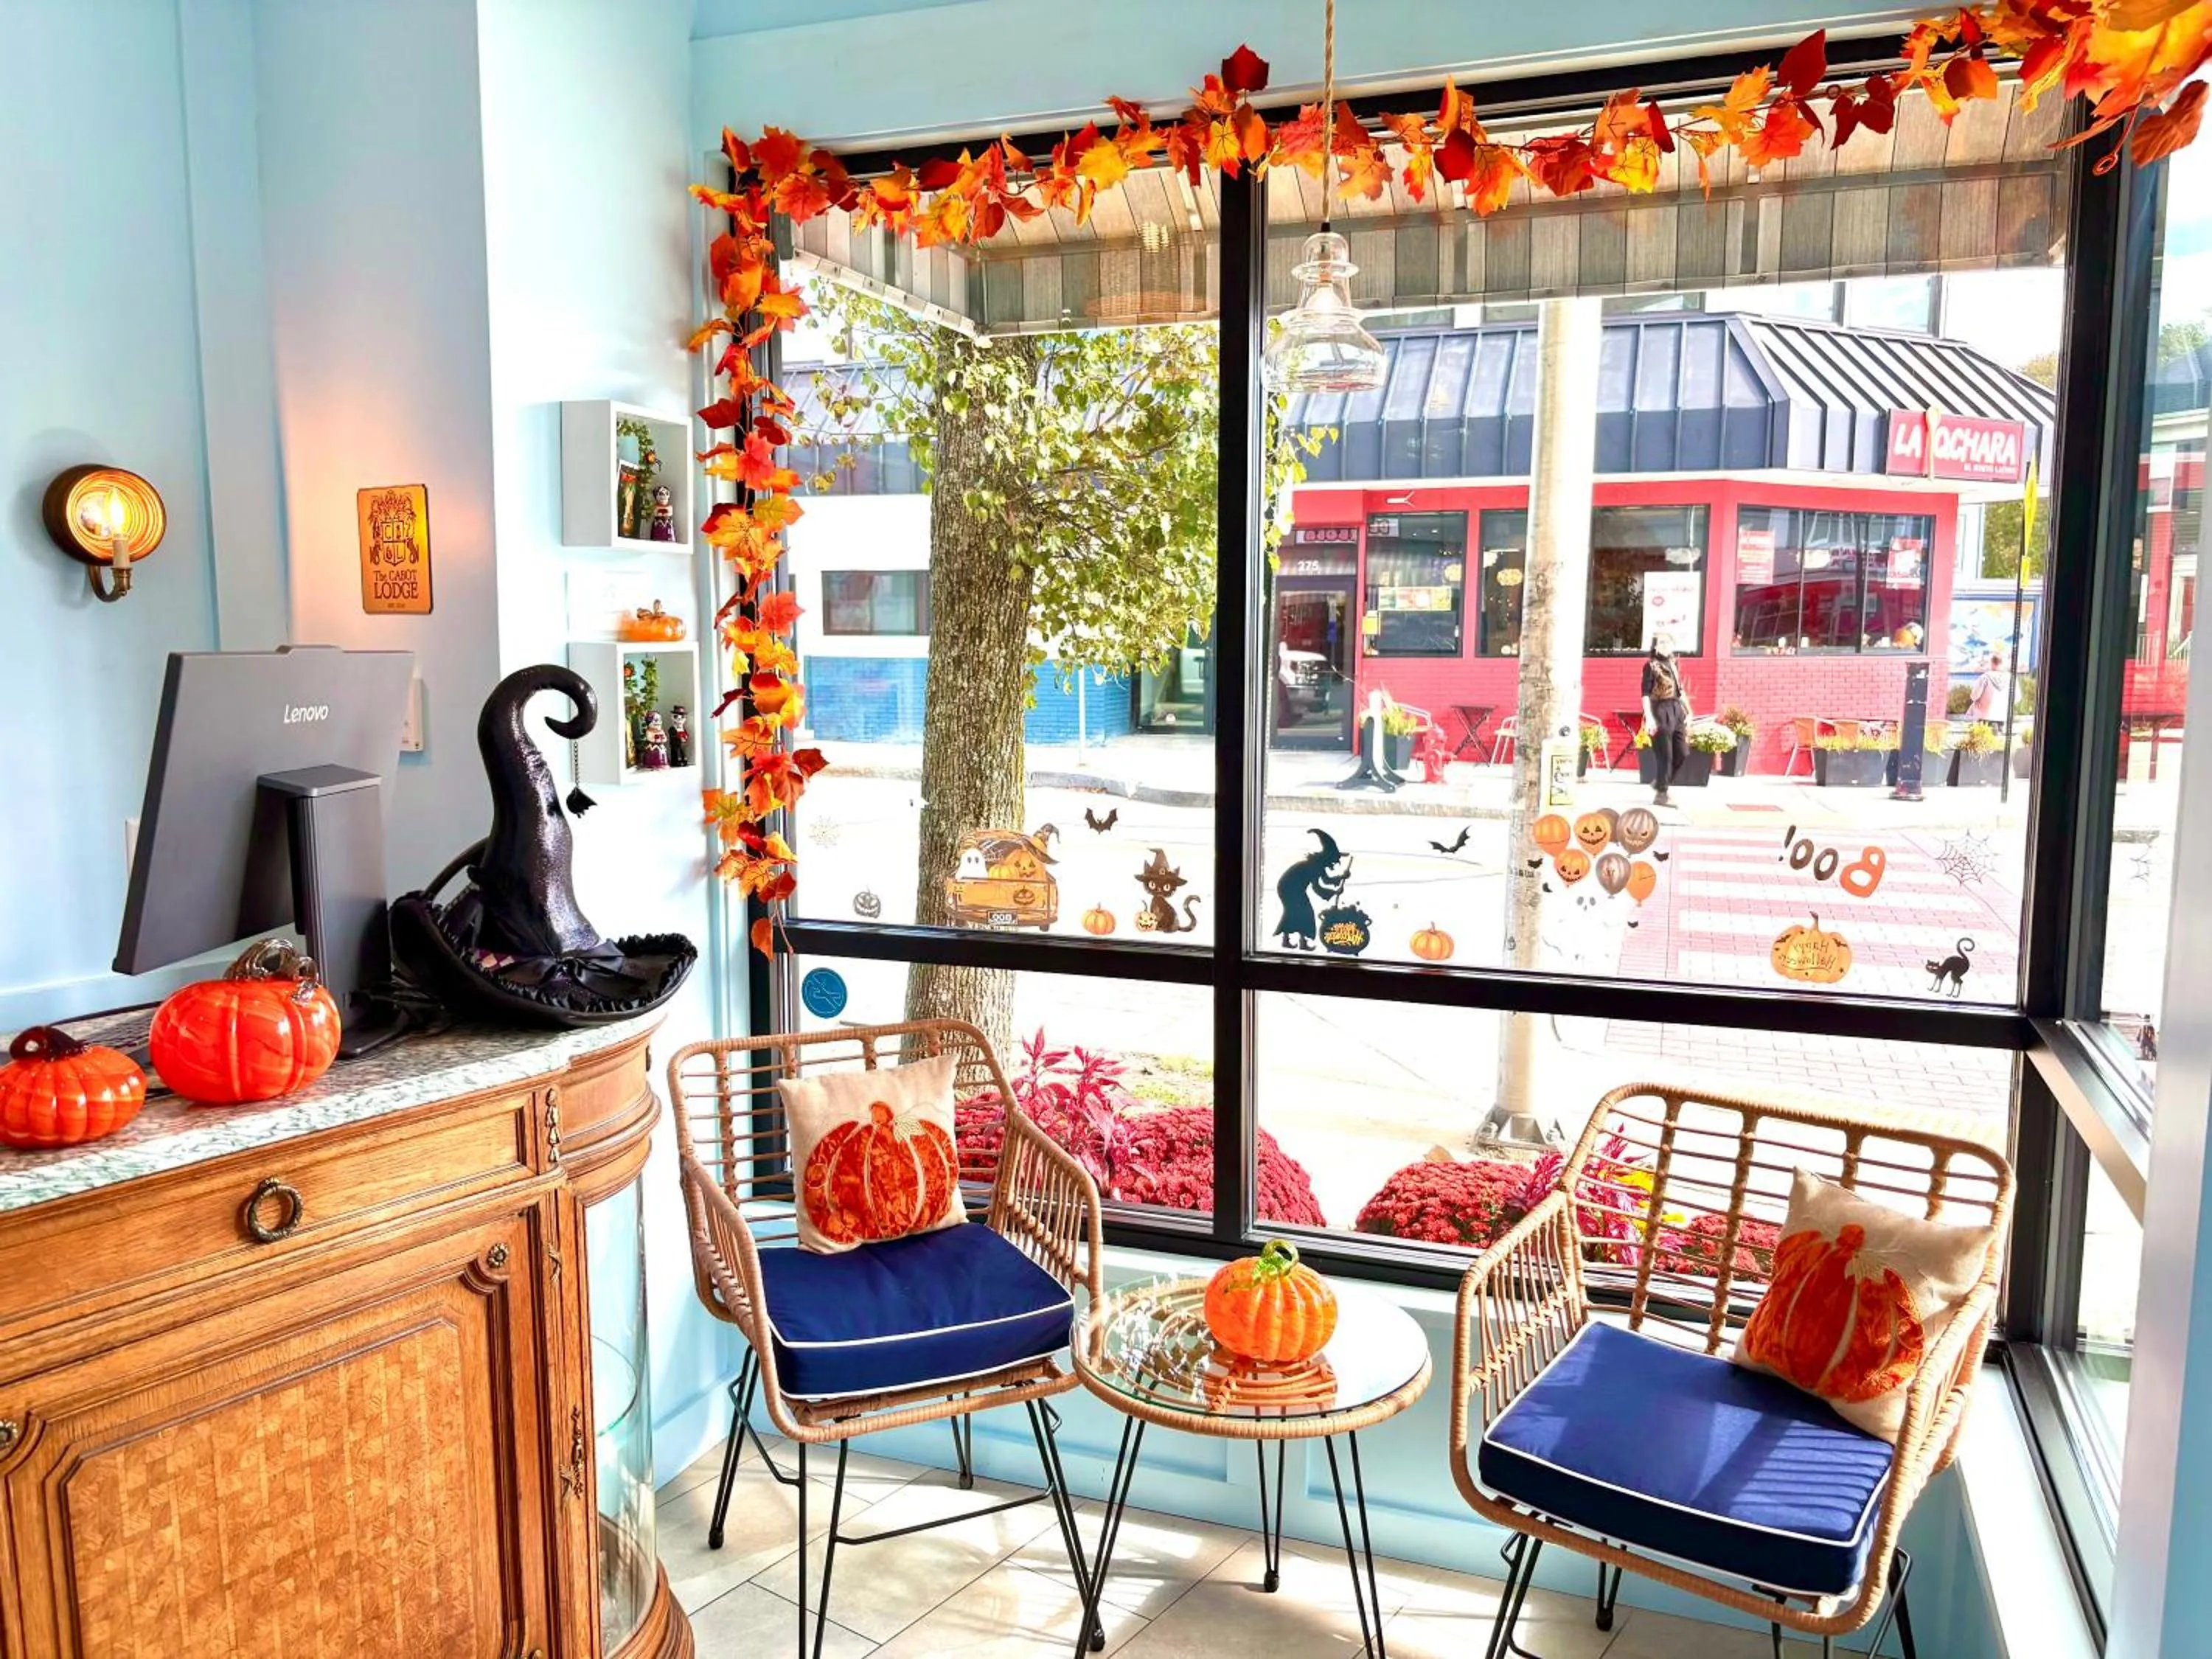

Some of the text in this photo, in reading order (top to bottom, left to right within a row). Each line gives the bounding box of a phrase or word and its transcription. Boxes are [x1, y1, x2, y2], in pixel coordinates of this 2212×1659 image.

[1894, 423, 1921, 459] LA
[1298, 560, 1319, 571] 275
[389, 569, 417, 581] CABOT
[374, 582, 419, 599] LODGE
[283, 703, 329, 723] Lenovo
